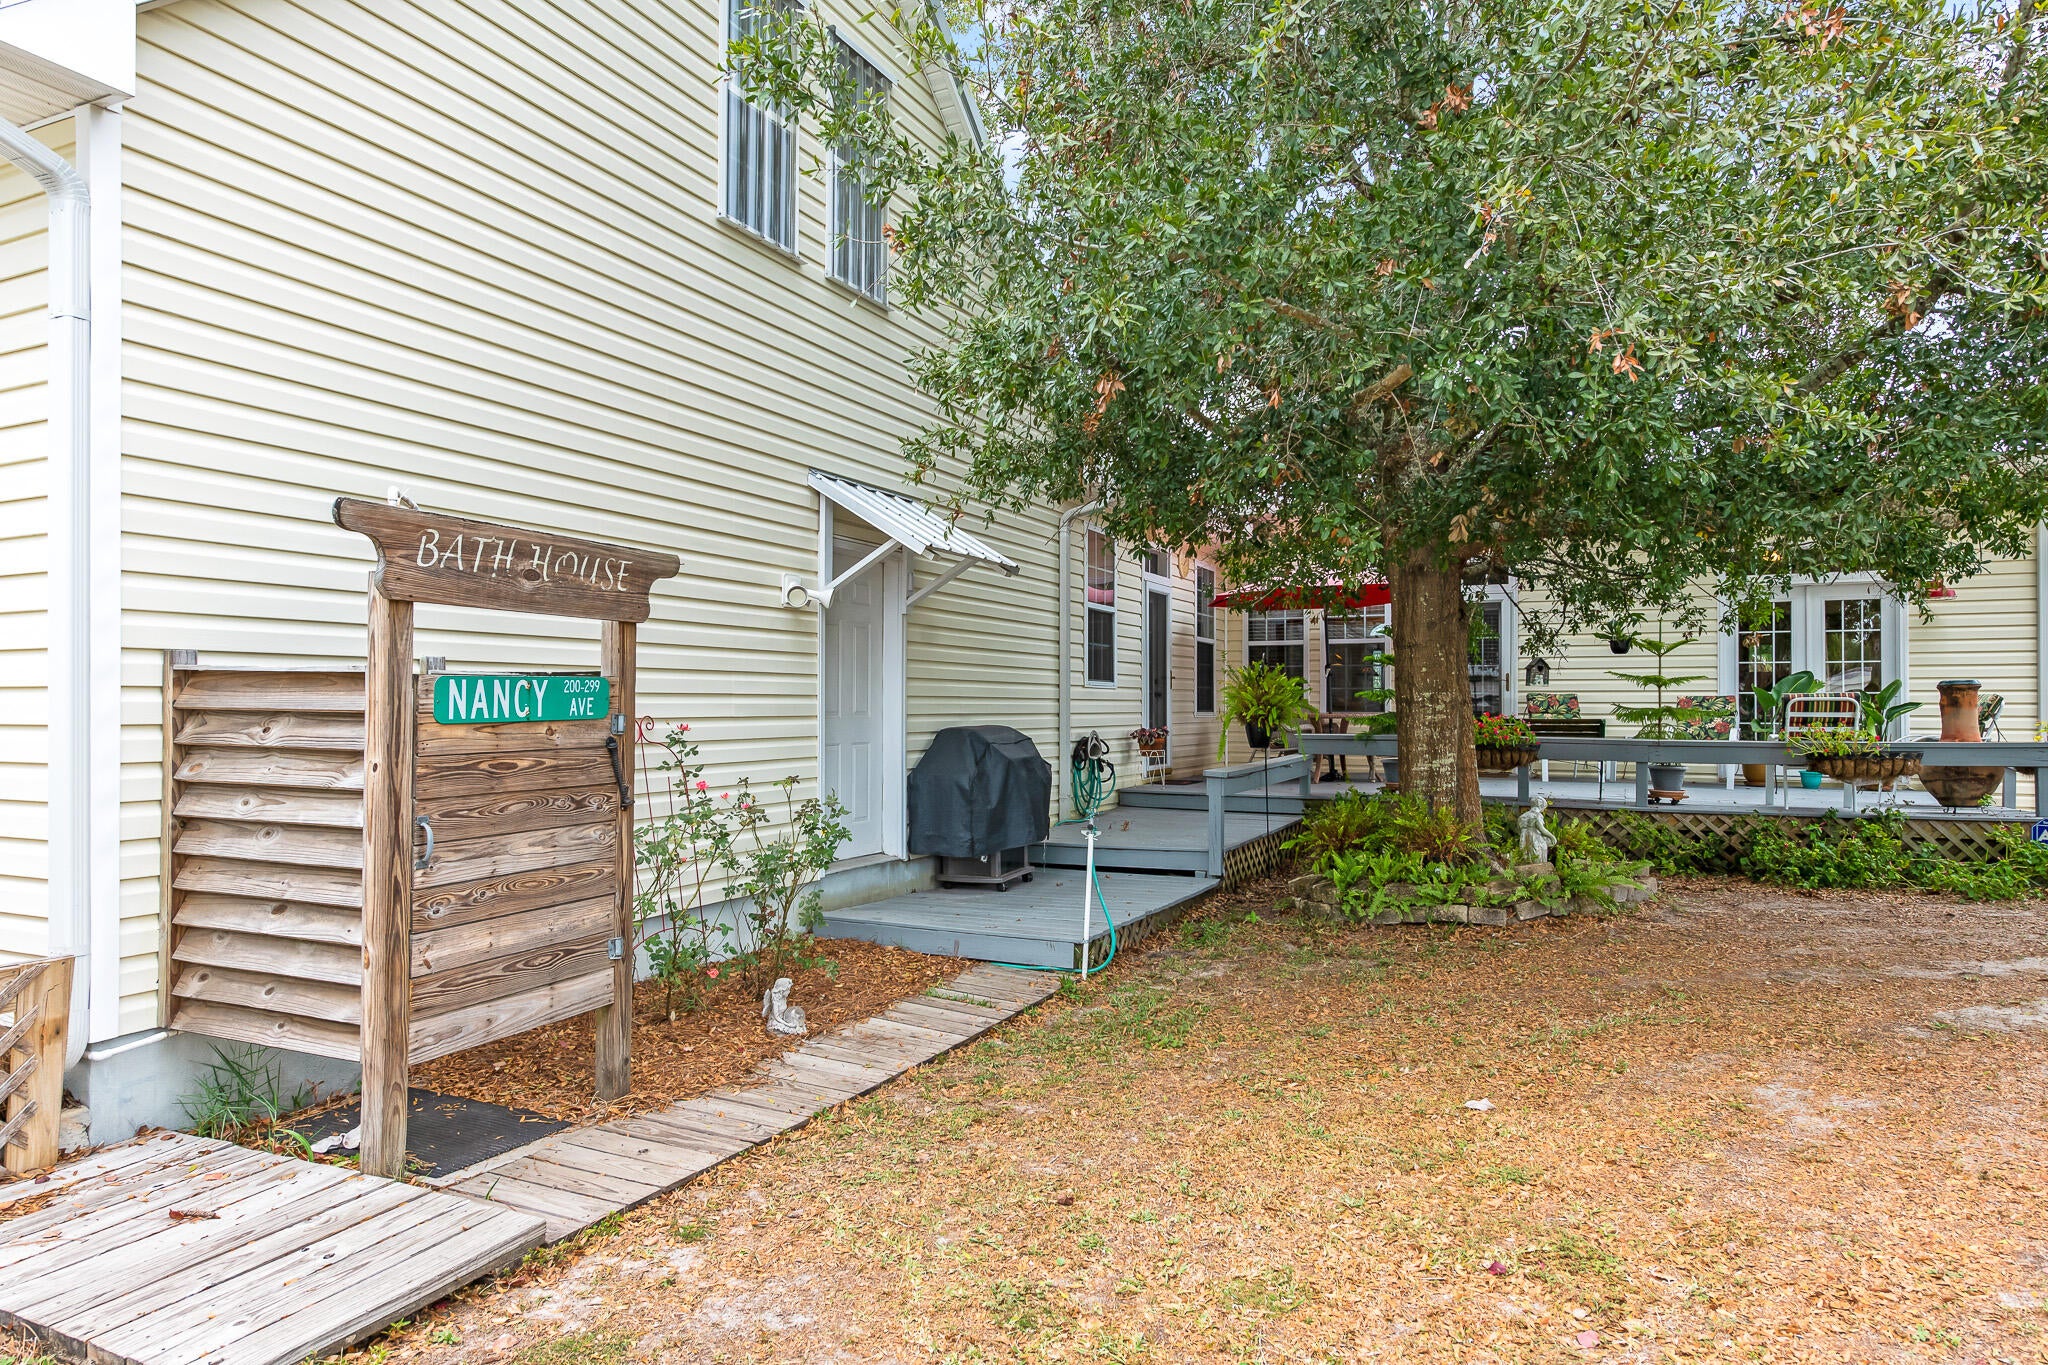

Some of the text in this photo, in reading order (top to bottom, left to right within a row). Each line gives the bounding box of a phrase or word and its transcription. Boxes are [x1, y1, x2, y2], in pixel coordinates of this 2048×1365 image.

[416, 528, 633, 592] BATH HOUSE
[448, 679, 549, 720] NANCY
[563, 679, 601, 694] 200-299
[569, 697, 594, 717] AVE
